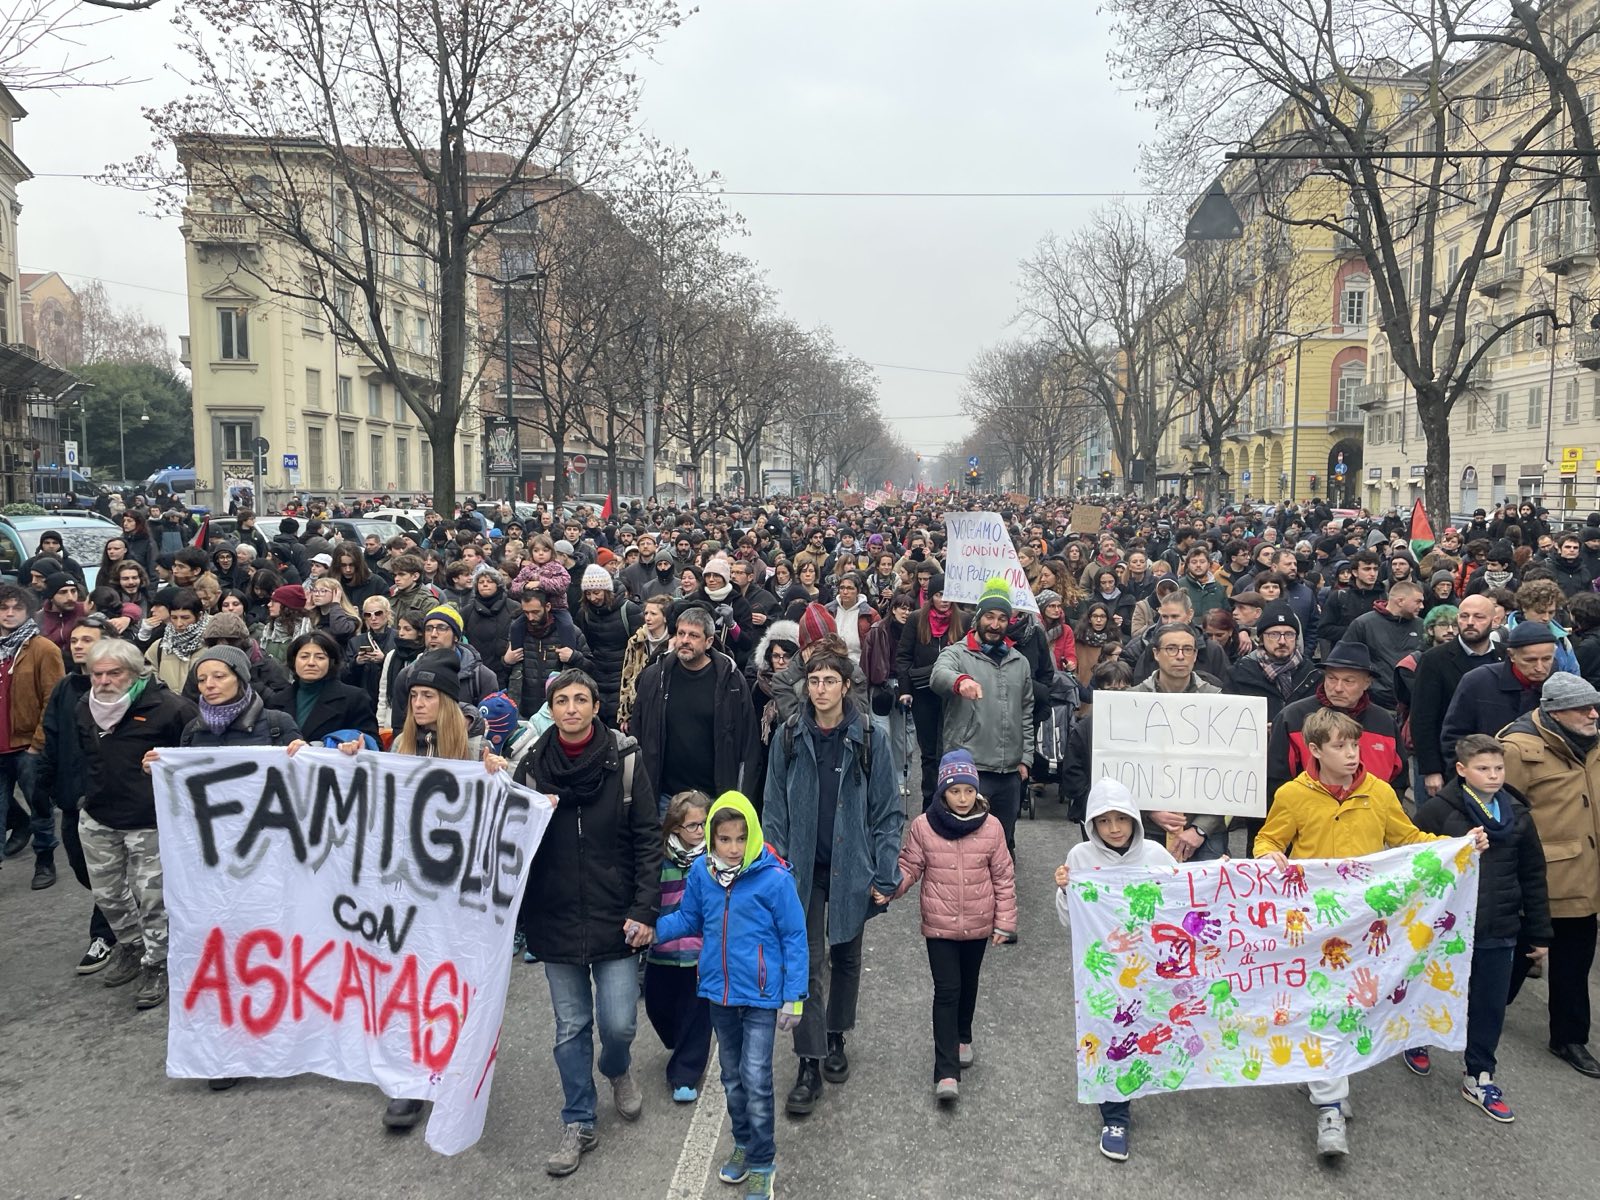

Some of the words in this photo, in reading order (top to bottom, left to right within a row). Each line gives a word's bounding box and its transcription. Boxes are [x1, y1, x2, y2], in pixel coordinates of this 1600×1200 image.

[284, 457, 298, 467] Park
[1109, 699, 1259, 751] L'ASKA
[1160, 765, 1183, 799] SI
[1187, 767, 1258, 804] TOCCA
[1238, 952, 1257, 967] di
